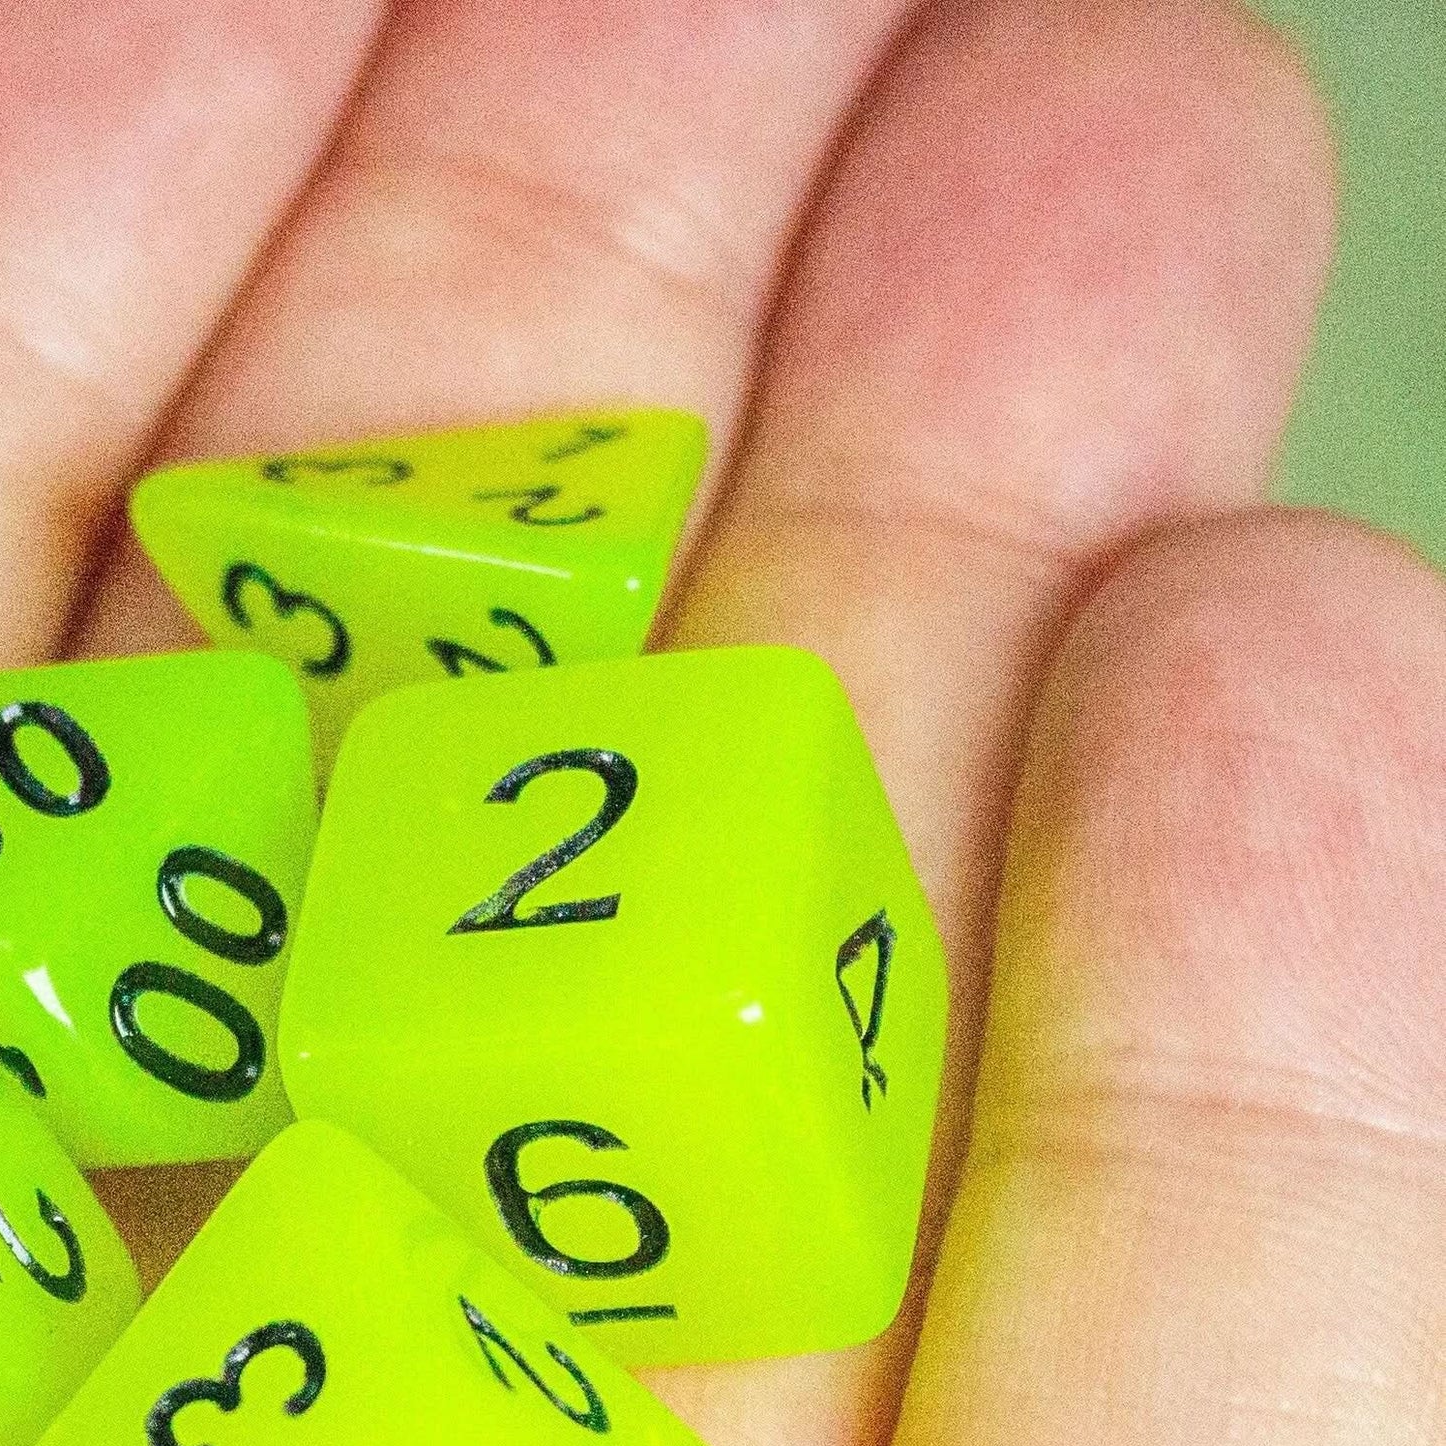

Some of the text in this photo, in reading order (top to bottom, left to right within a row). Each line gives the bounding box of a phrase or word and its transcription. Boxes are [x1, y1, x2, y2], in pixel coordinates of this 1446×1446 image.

[221, 560, 353, 681] 3
[449, 747, 639, 936] 2
[109, 845, 289, 1104] 00
[835, 907, 896, 1111] 4
[459, 1296, 610, 1436] 2
